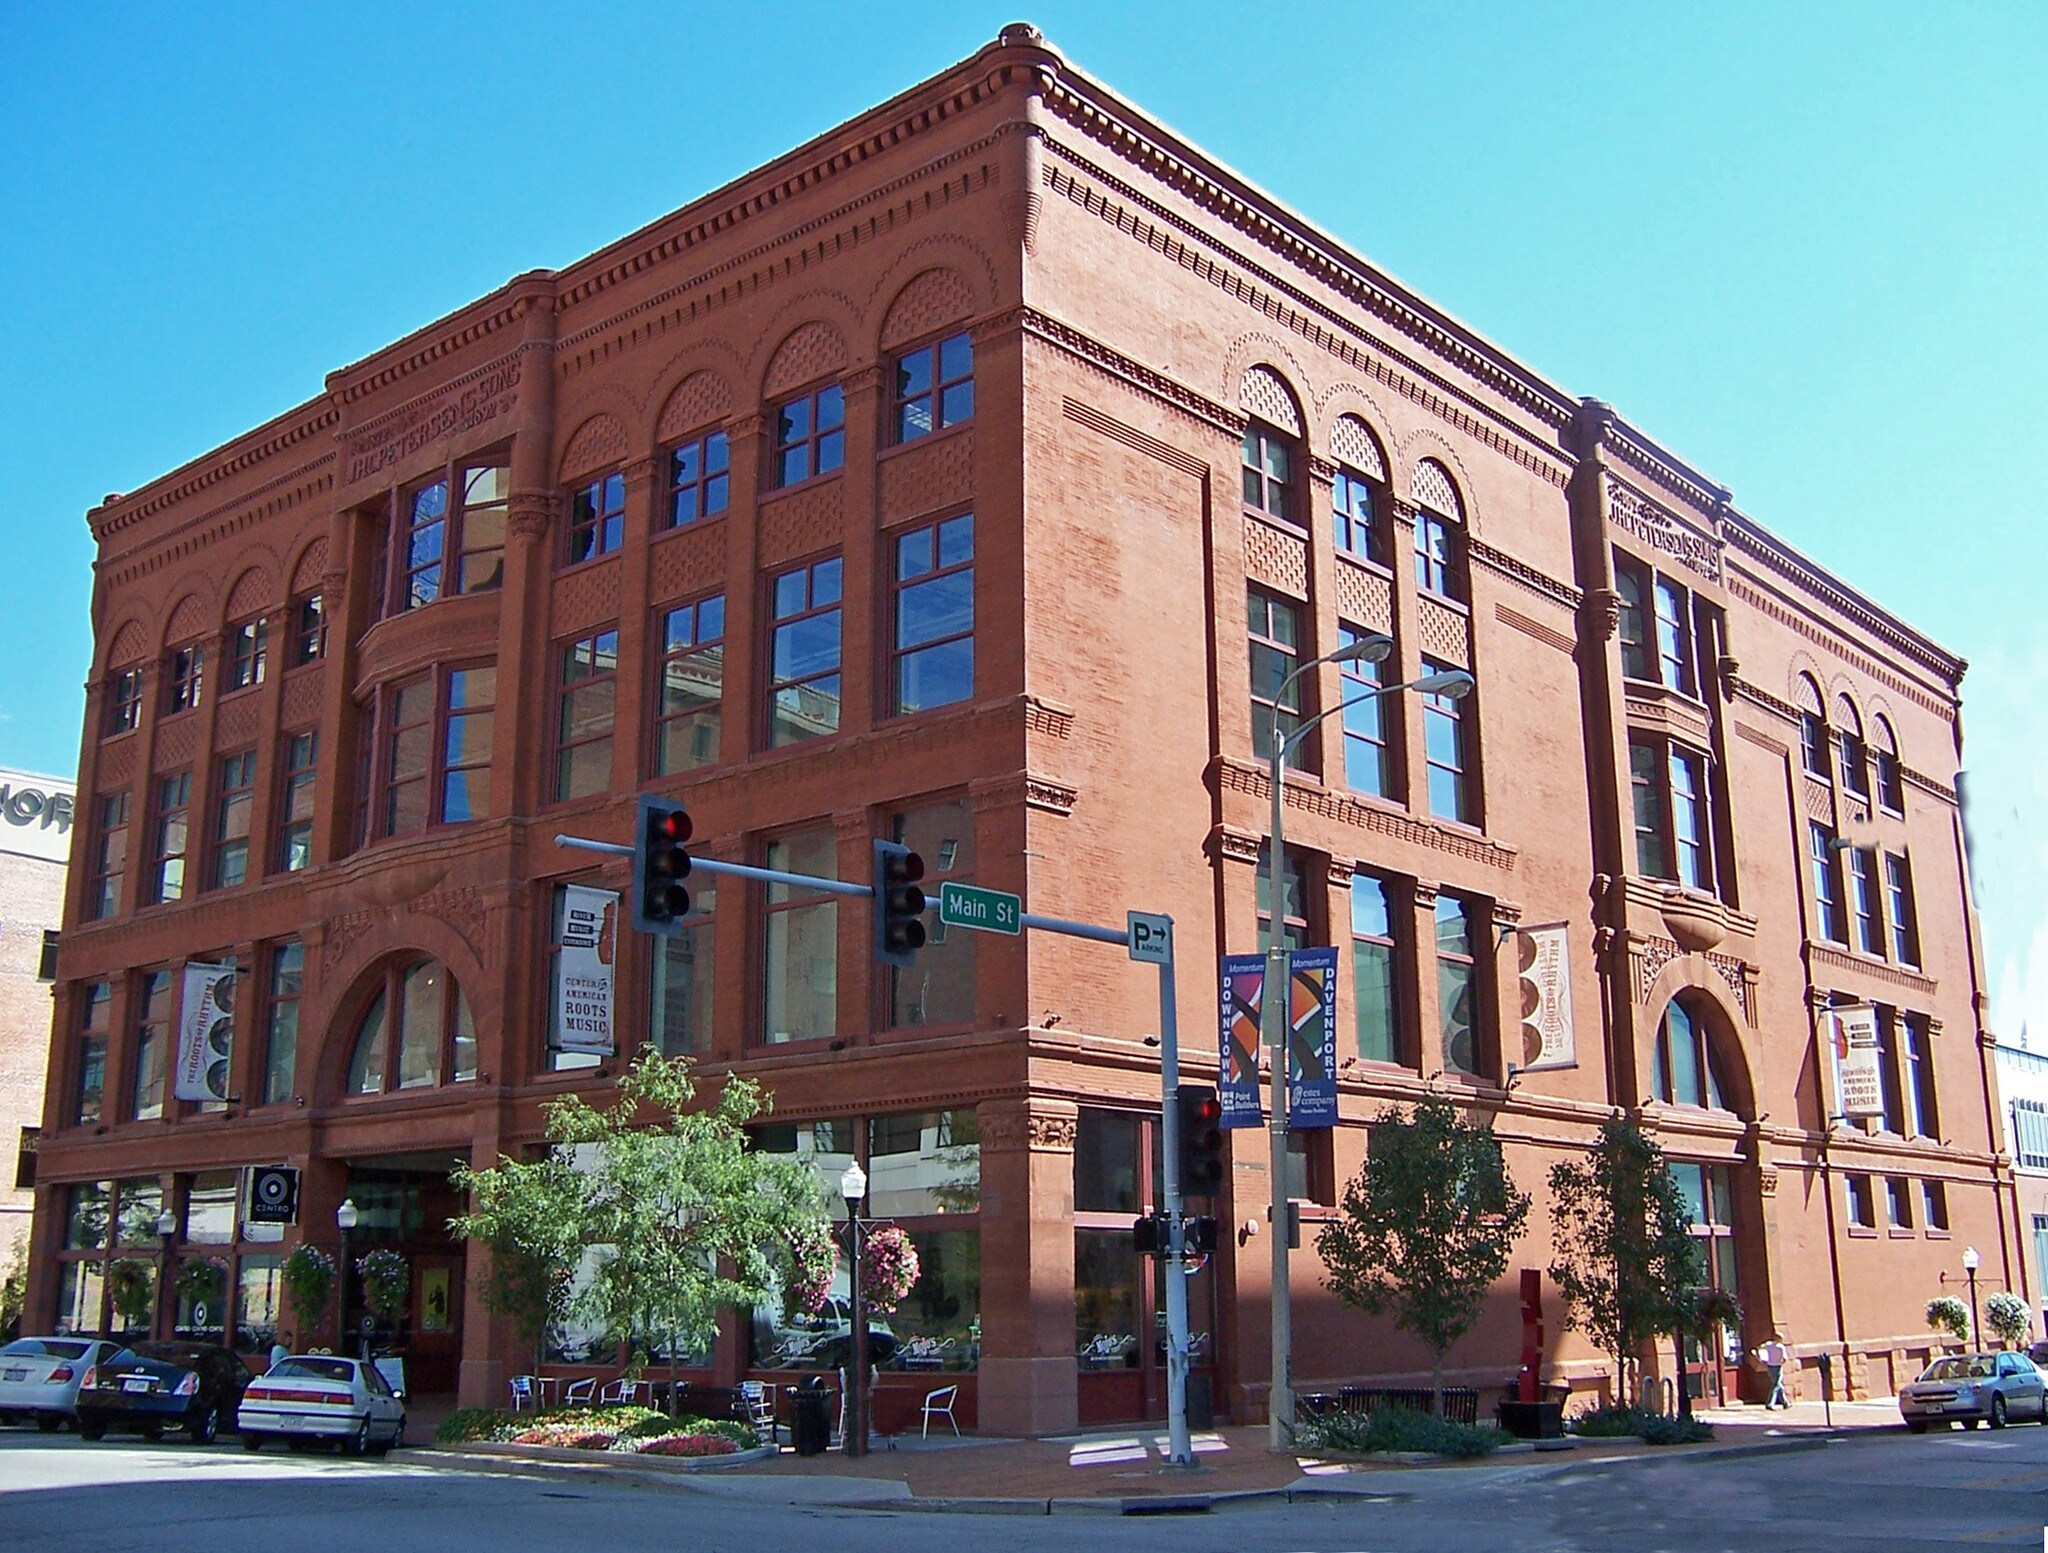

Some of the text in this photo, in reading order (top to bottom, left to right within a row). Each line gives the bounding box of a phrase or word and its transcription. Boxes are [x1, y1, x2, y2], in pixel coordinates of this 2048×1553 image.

[949, 893, 1014, 924] Main St
[1229, 964, 1265, 973] Momentum
[1292, 958, 1330, 968] Momentum
[566, 990, 607, 1001] AMERICAN
[566, 1002, 607, 1018] ROOTS
[190, 1035, 203, 1070] ROOTS
[198, 985, 214, 1028] RHYTHM
[566, 1018, 607, 1034] MUSIC
[1221, 976, 1231, 1084] DOWNTOWN
[1324, 967, 1335, 1080] DAVENPORT
[256, 1204, 289, 1212] CENTRO
